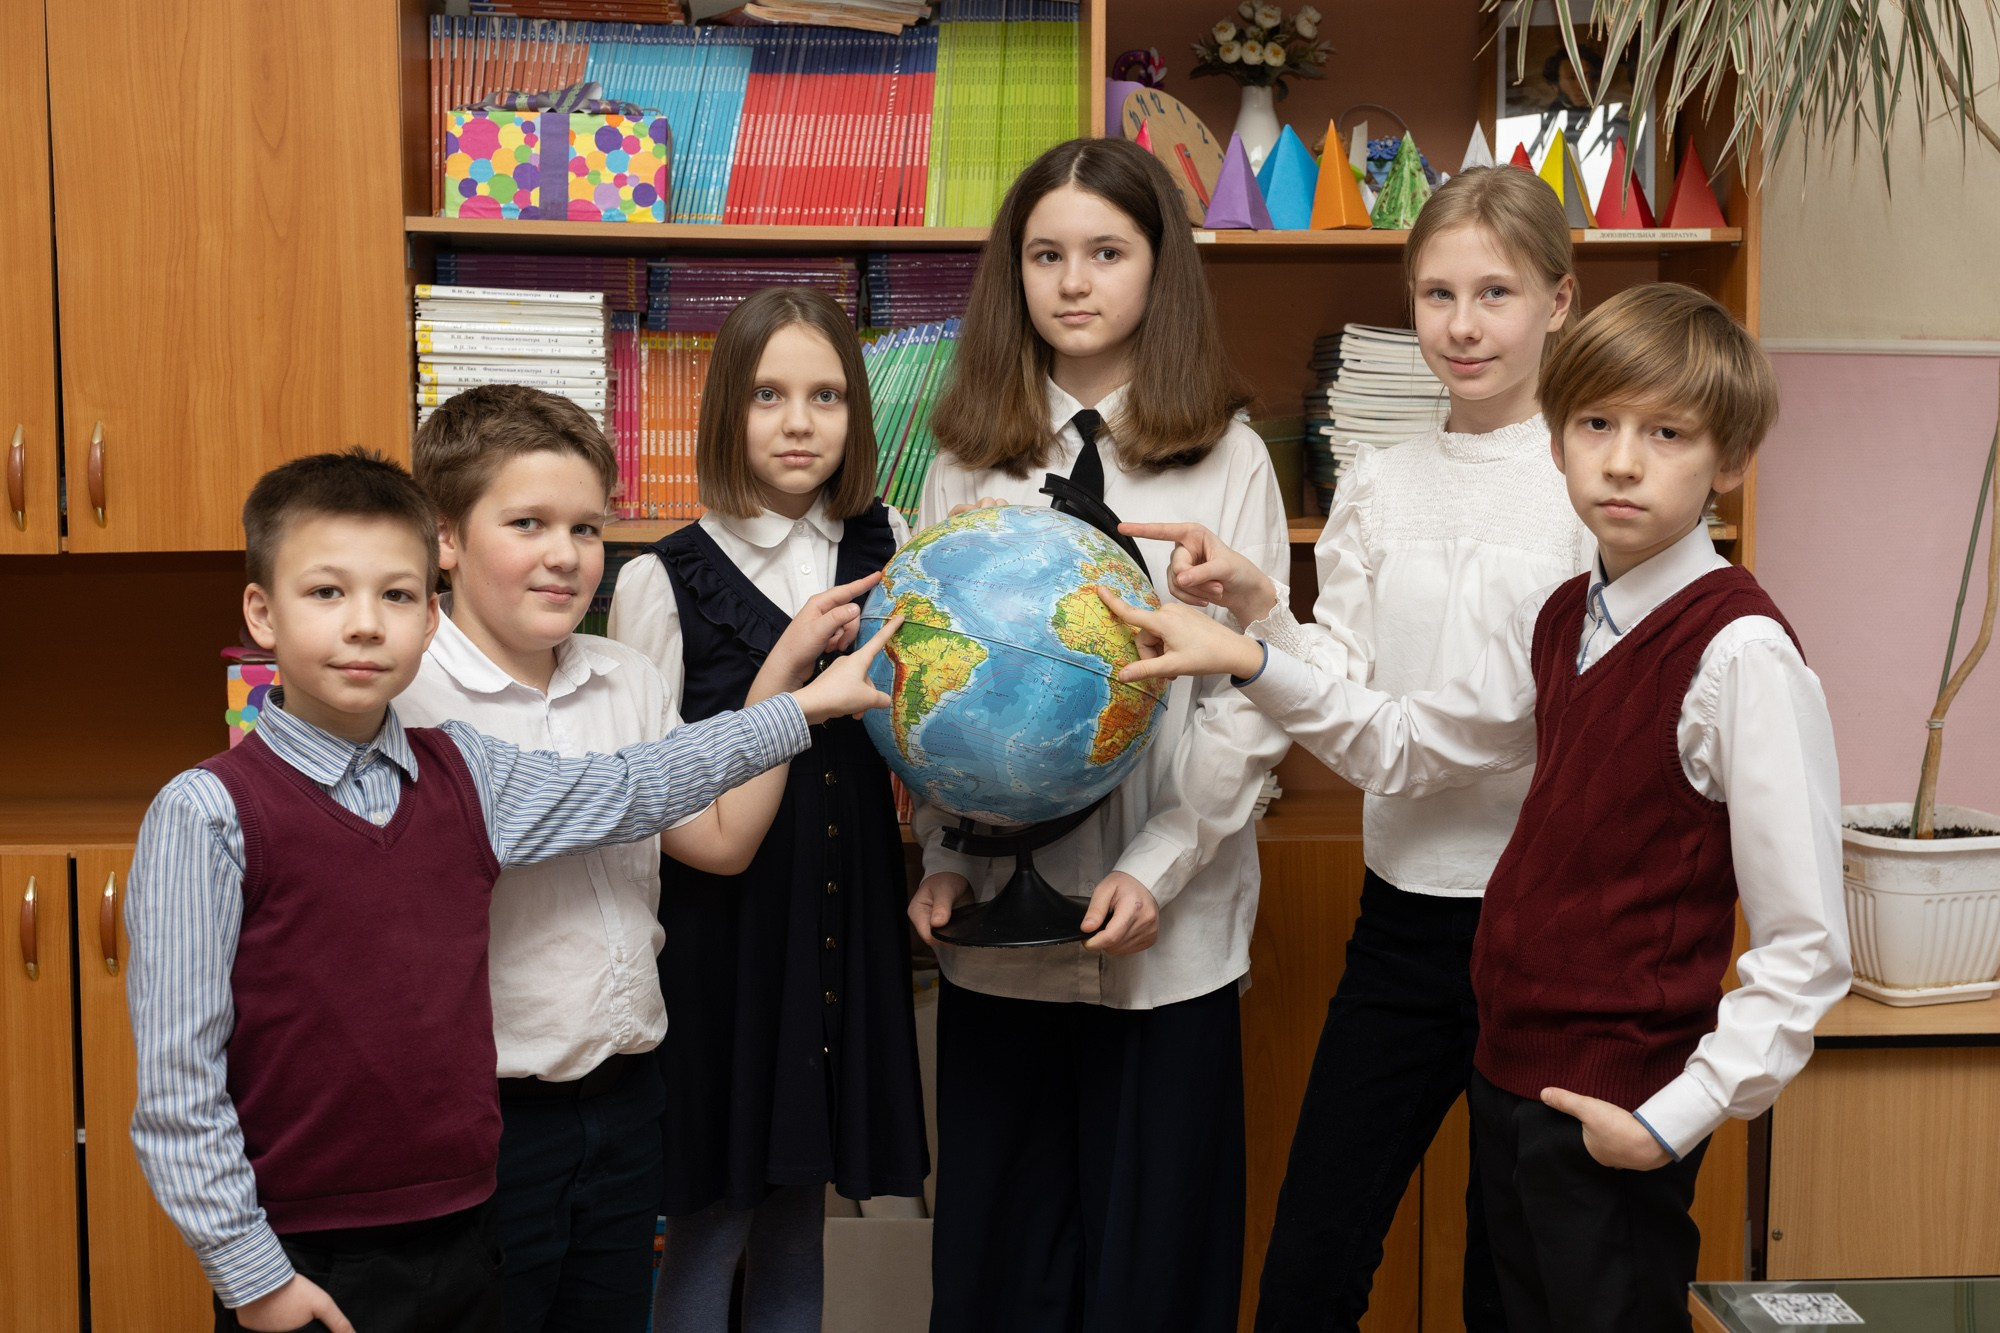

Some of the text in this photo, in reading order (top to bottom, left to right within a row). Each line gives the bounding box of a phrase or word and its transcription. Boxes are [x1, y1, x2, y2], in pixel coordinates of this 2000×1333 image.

[1136, 94, 1150, 116] 11
[1150, 92, 1165, 114] 12
[1176, 103, 1186, 124] 1
[1197, 122, 1208, 144] 2
[642, 474, 647, 482] 3
[650, 474, 656, 482] 3
[659, 474, 665, 483] 3
[668, 474, 673, 483] 3
[676, 474, 682, 483] 3
[685, 475, 691, 483] 3
[1034, 678, 1068, 692] ОКЕАН
